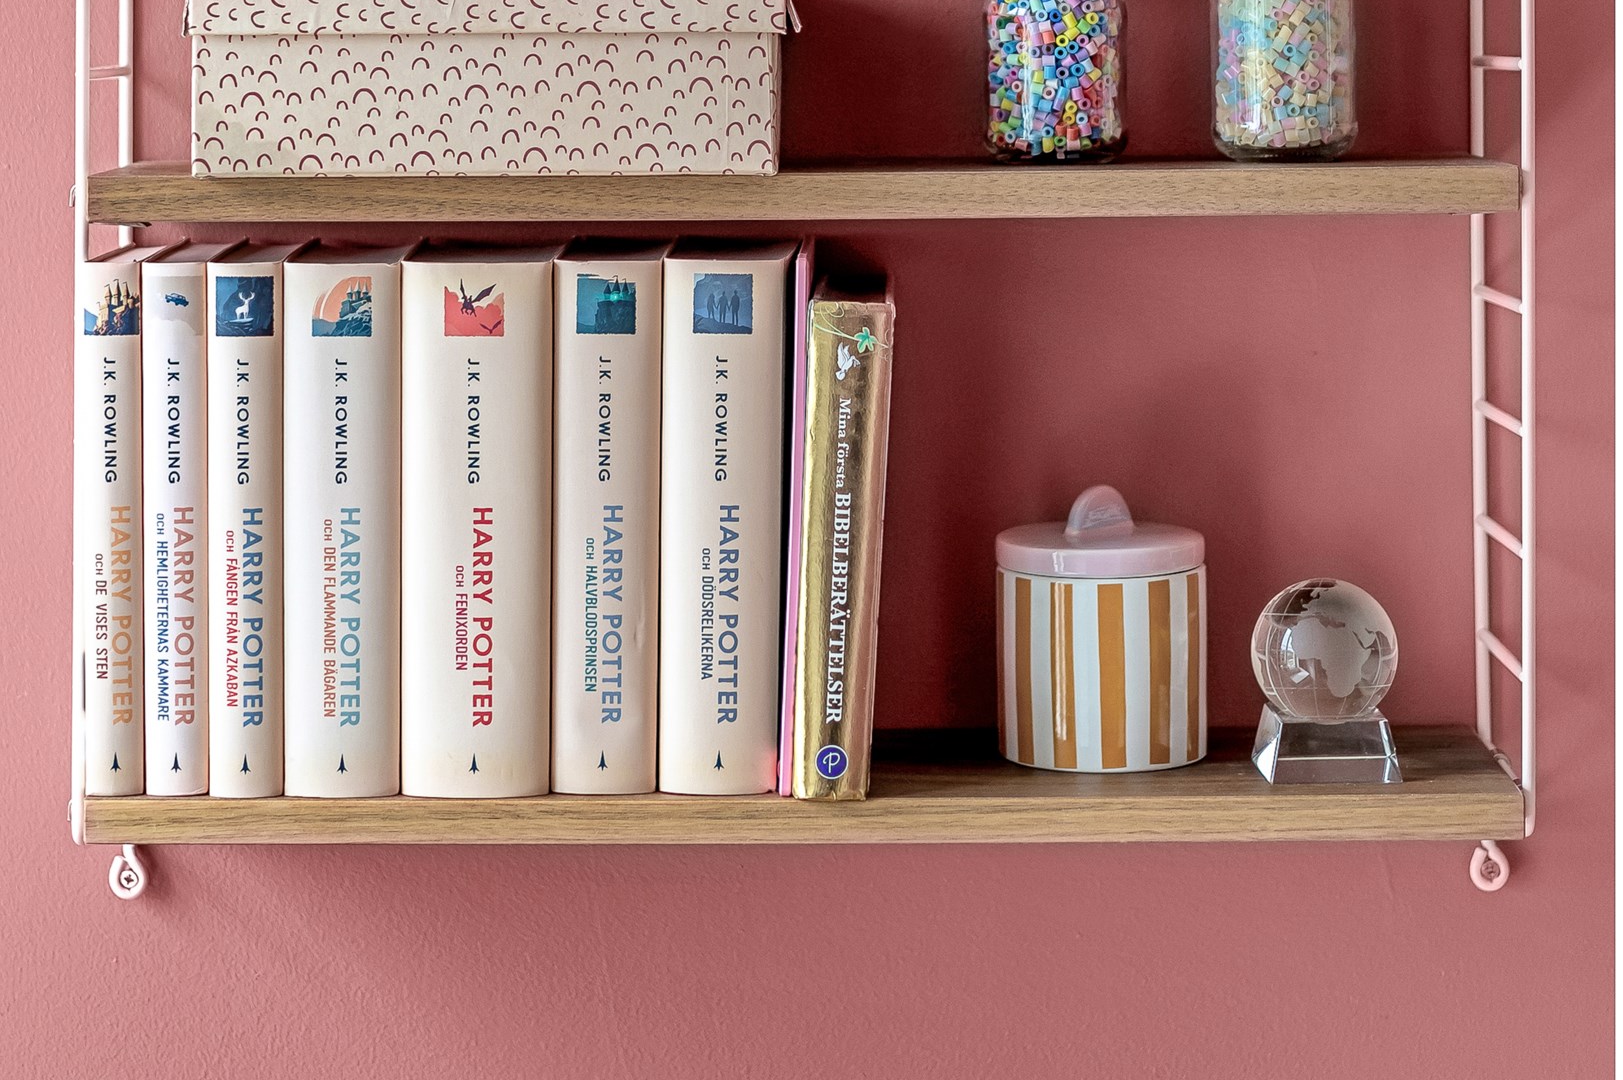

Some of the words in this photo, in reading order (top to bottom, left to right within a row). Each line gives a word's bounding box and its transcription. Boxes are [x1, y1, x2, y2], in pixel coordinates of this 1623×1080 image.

[102, 356, 116, 387] J.K.
[166, 357, 179, 388] J.K.
[236, 358, 249, 389] J.K.
[334, 357, 347, 388] J.K.
[466, 357, 479, 388] J.K.
[598, 355, 611, 386] J.K.
[715, 355, 727, 386] J.K.
[104, 394, 117, 482] ROWLING
[167, 396, 180, 483] ROWLING
[237, 396, 249, 484] ROWLING
[335, 396, 347, 484] ROWLING
[467, 395, 479, 483] ROWLING
[598, 393, 611, 481] ROWLING
[714, 393, 727, 481] ROWLING
[838, 396, 853, 436] Mina
[835, 440, 850, 489] första
[110, 505, 131, 603] HARRY
[174, 506, 195, 603] HARRY
[226, 530, 234, 552] OCH
[242, 507, 263, 605] HARRY
[323, 546, 336, 571] DEN
[324, 519, 332, 541] OCH
[340, 507, 360, 604] HARRY
[473, 507, 493, 604] HARRY
[586, 537, 594, 559] OCH
[603, 504, 623, 602] HARRY
[702, 548, 710, 570] OCH
[720, 504, 740, 602] HARRY
[96, 580, 107, 595] DE
[156, 541, 168, 652] HEMLIGHETERNAS
[226, 558, 238, 605] FÅNGEN
[323, 576, 336, 653] FLAMMANDE
[456, 566, 464, 587] OCH
[826, 492, 851, 724] BIBELBERÄTTELSER
[96, 602, 107, 640] VISES
[226, 611, 240, 643] FRÅN
[456, 593, 468, 670] FENIXORDEN
[584, 565, 597, 691] HALVBLODSPRINSEN
[701, 576, 716, 680] DÖDSRELIKERNA
[97, 648, 108, 679] STEN
[112, 615, 133, 726] POTTER
[157, 658, 169, 720] KAMMARE
[174, 615, 195, 726] POTTER
[226, 649, 238, 706] AZKABAN
[242, 617, 263, 728] POTTER
[323, 660, 338, 717] BÄGAREN
[340, 616, 360, 728] POTTER
[473, 616, 492, 727] POTTER
[602, 614, 623, 723] POTTER
[718, 614, 739, 724] POTTER
